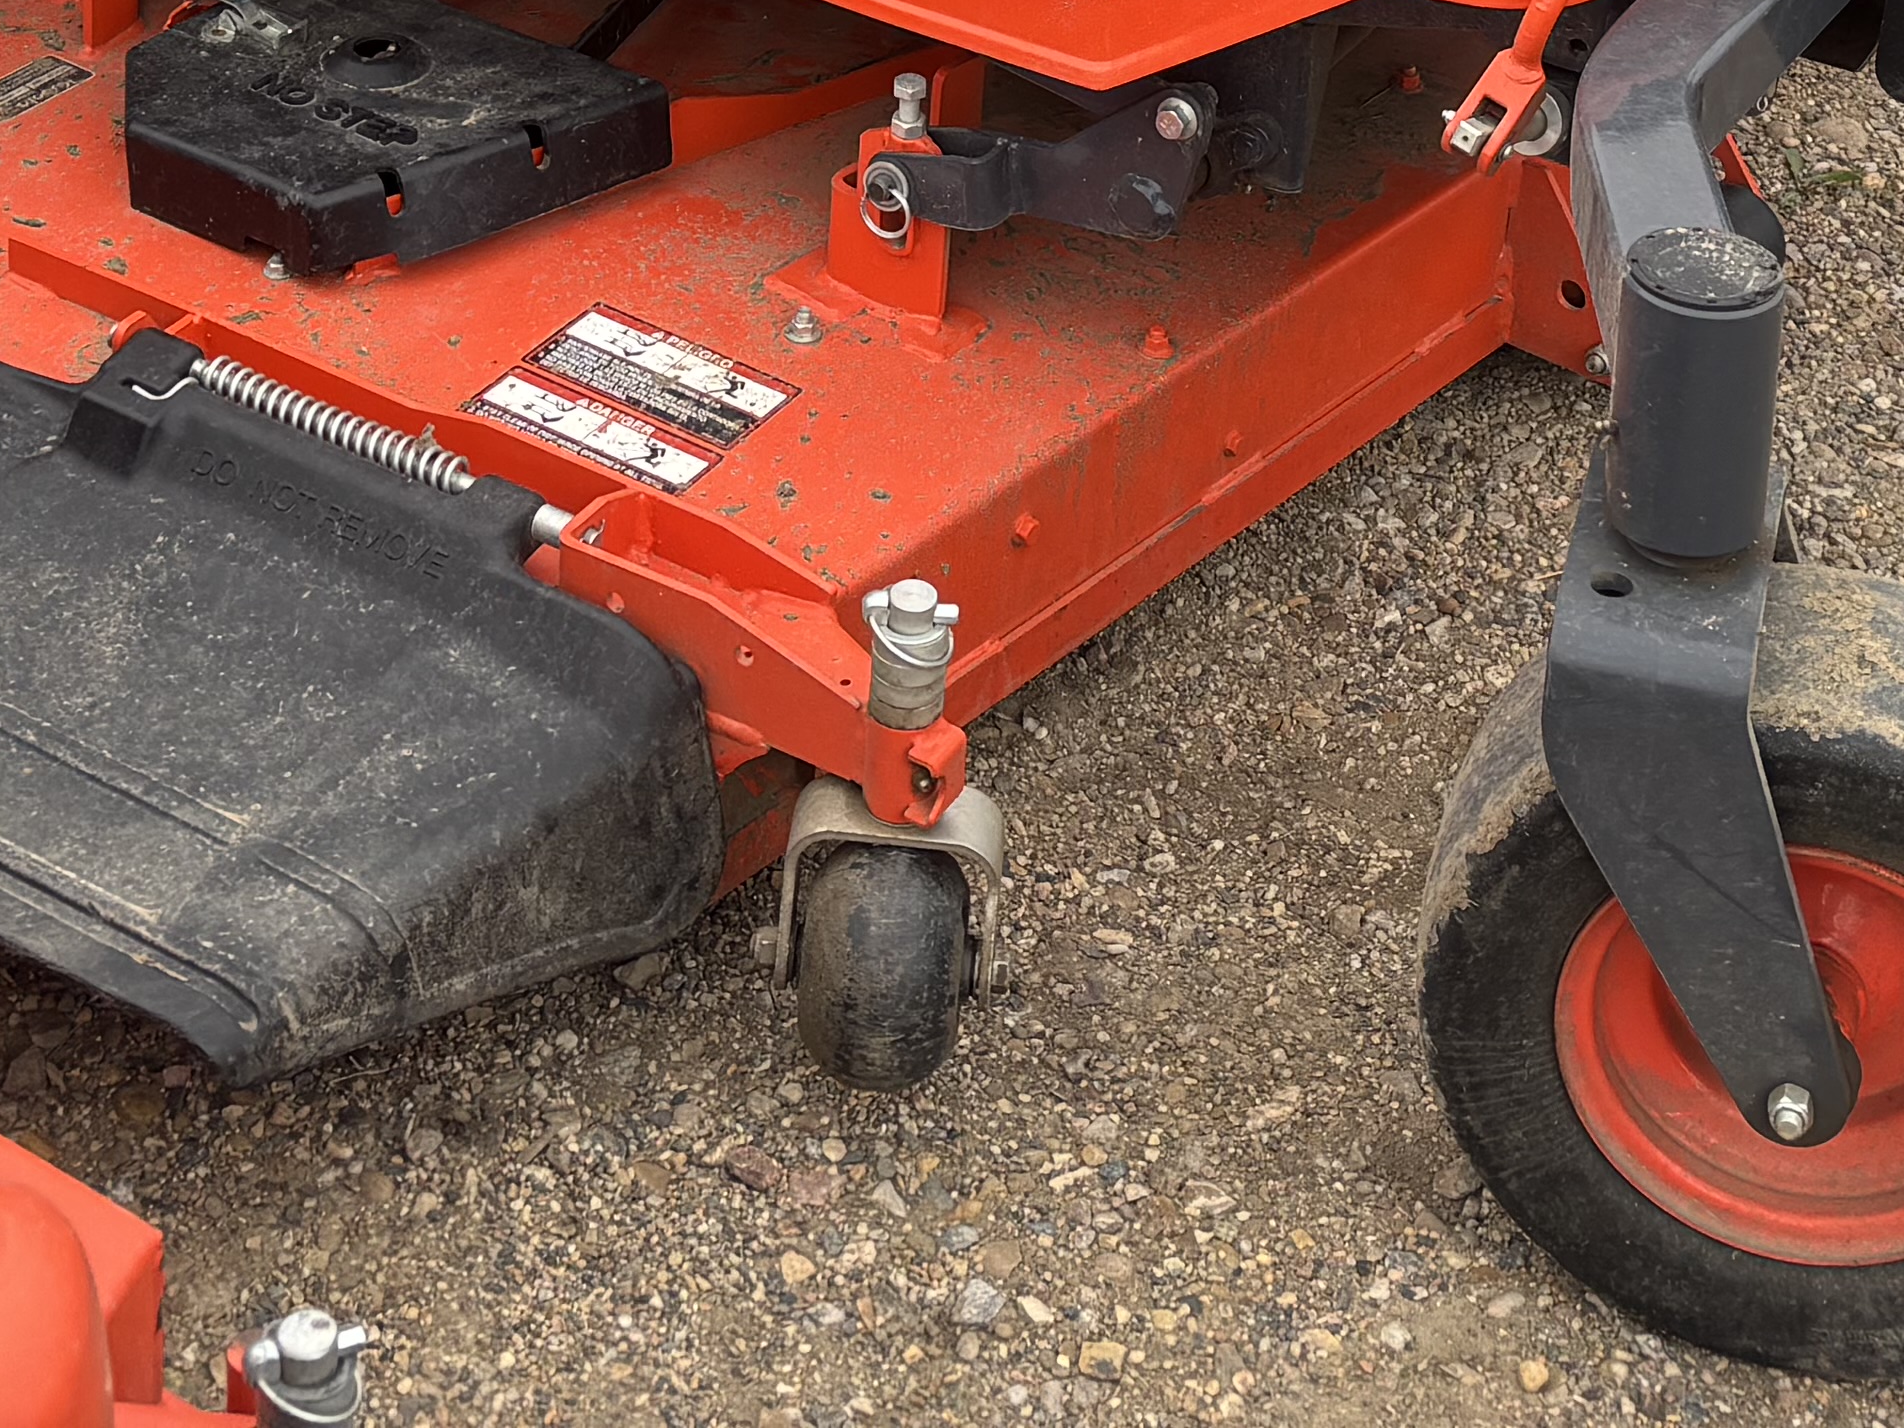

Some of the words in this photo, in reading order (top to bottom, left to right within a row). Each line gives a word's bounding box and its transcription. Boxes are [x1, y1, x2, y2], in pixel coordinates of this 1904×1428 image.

[249, 71, 318, 108] NO
[189, 448, 239, 487] DO
[247, 477, 319, 520] NOT
[317, 504, 451, 580] REMOVE
